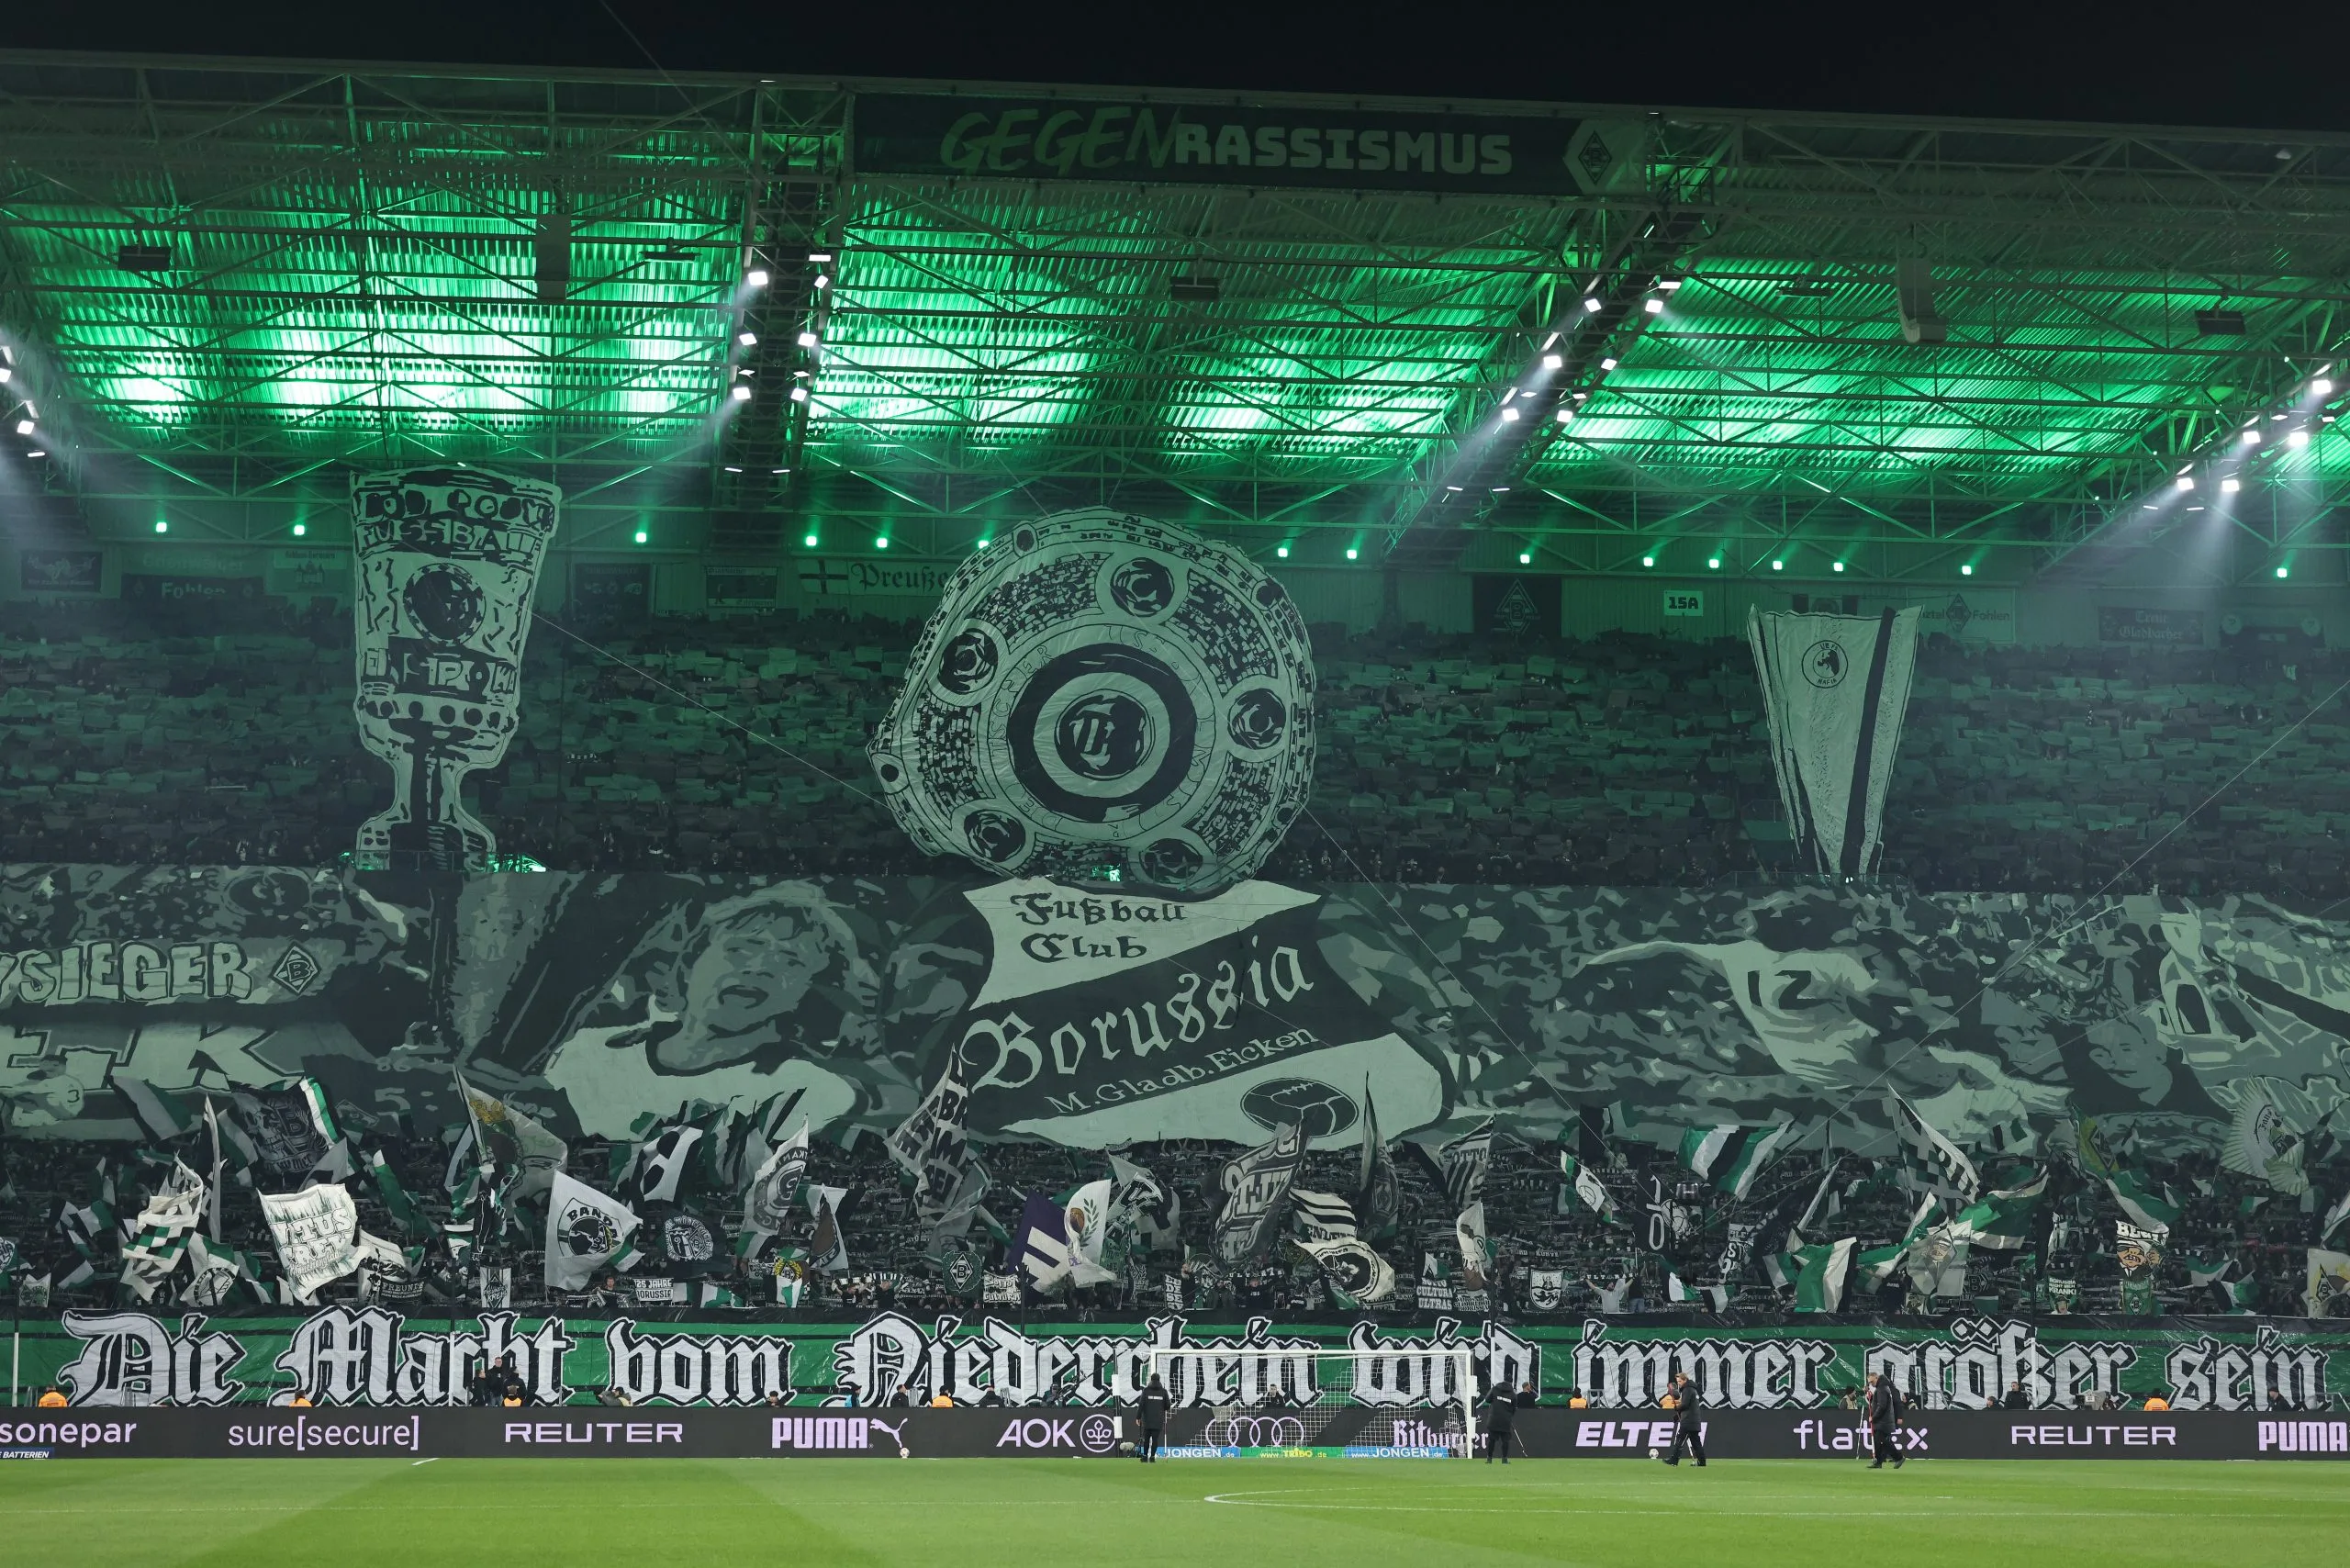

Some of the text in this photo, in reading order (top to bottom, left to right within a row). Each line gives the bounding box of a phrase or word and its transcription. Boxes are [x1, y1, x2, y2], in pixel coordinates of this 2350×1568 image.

[941, 106, 1513, 176] GEGEN RASSISMUS
[1668, 595, 1699, 611] 15A
[1973, 610, 2010, 622] Fohlen
[1011, 892, 1184, 926] Fußball
[1020, 933, 1147, 963] Club
[960, 935, 1314, 1093] Borussia
[269, 1208, 352, 1246] VITUS
[648, 1279, 672, 1288] JAHRE
[1416, 1285, 1453, 1298] CULTURA
[1418, 1297, 1452, 1310] ULTRAS
[58, 1309, 245, 1406] Die
[269, 1305, 576, 1406] Macht
[605, 1316, 797, 1406] vom
[819, 1311, 1322, 1407] Niederrhein
[1348, 1316, 1541, 1407] wird
[1572, 1319, 1836, 1409] immer
[2166, 1326, 2332, 1411] sein
[0, 1422, 137, 1448] sonepar
[228, 1415, 420, 1450] sure[secure]
[505, 1422, 682, 1443] REUTER
[772, 1417, 868, 1449] PUMA
[997, 1419, 1075, 1448] AOK
[2011, 1425, 2177, 1446] REUTER
[2258, 1422, 2347, 1451] PUMA
[3, 1450, 50, 1459] BATTERIEN
